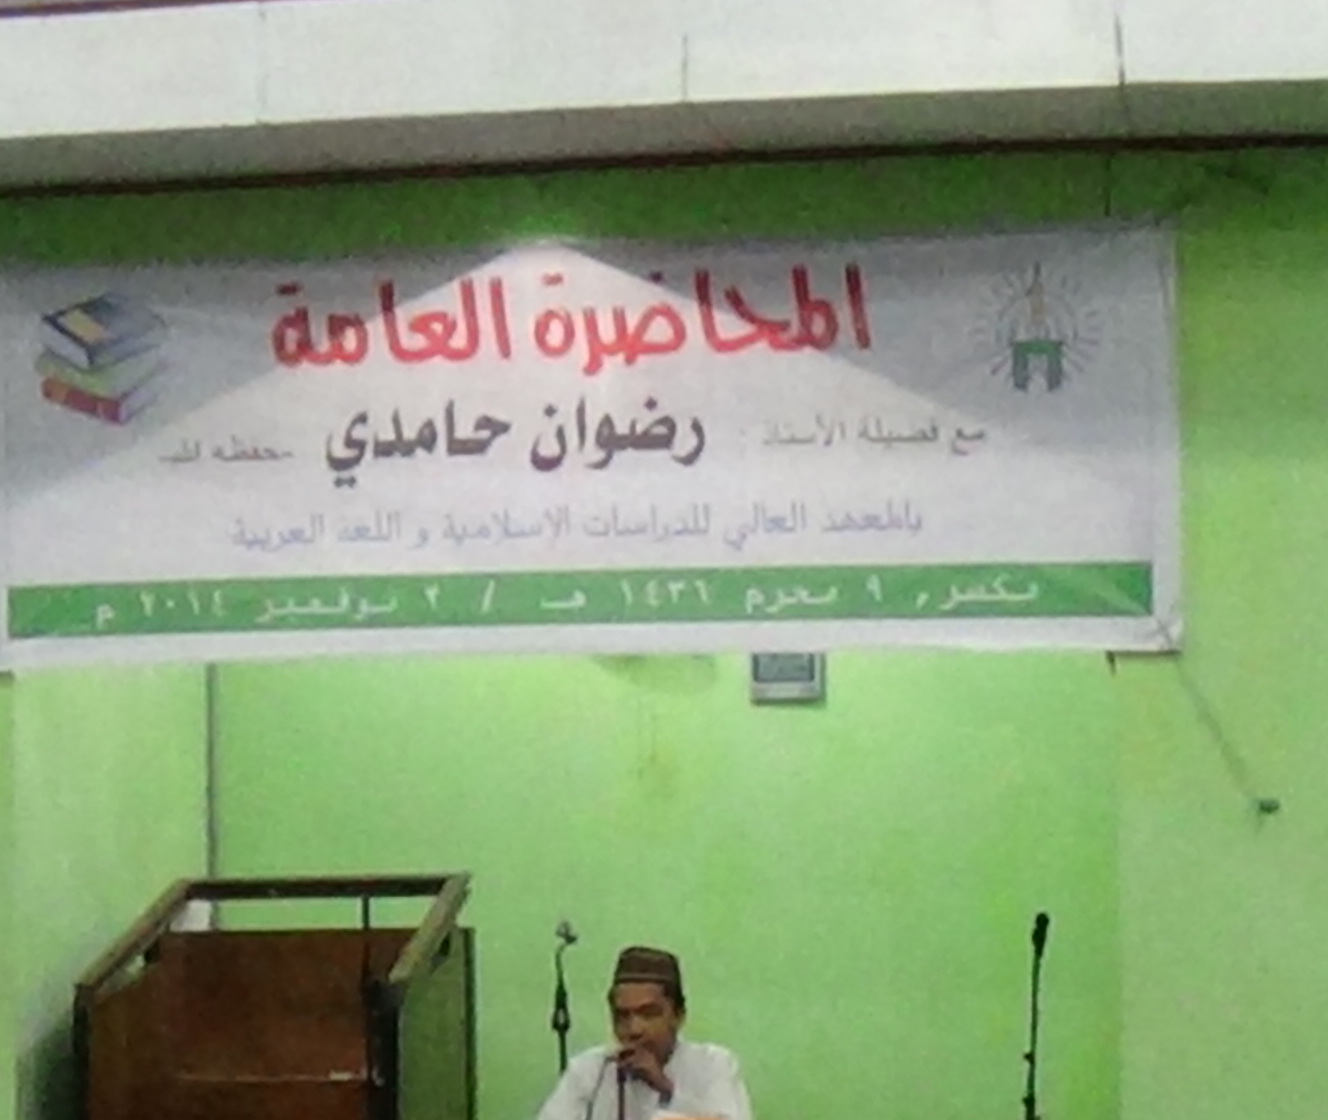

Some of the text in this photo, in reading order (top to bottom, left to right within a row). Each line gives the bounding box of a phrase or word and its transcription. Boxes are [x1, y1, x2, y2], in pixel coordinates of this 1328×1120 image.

[272, 262, 871, 376] المحاضرة العامة
[326, 400, 512, 488] حامدي
[530, 396, 706, 472] رضوان
[226, 514, 324, 553] العربية
[405, 525, 430, 551] و
[581, 502, 710, 544] للدراسات
[722, 500, 807, 551] العالي
